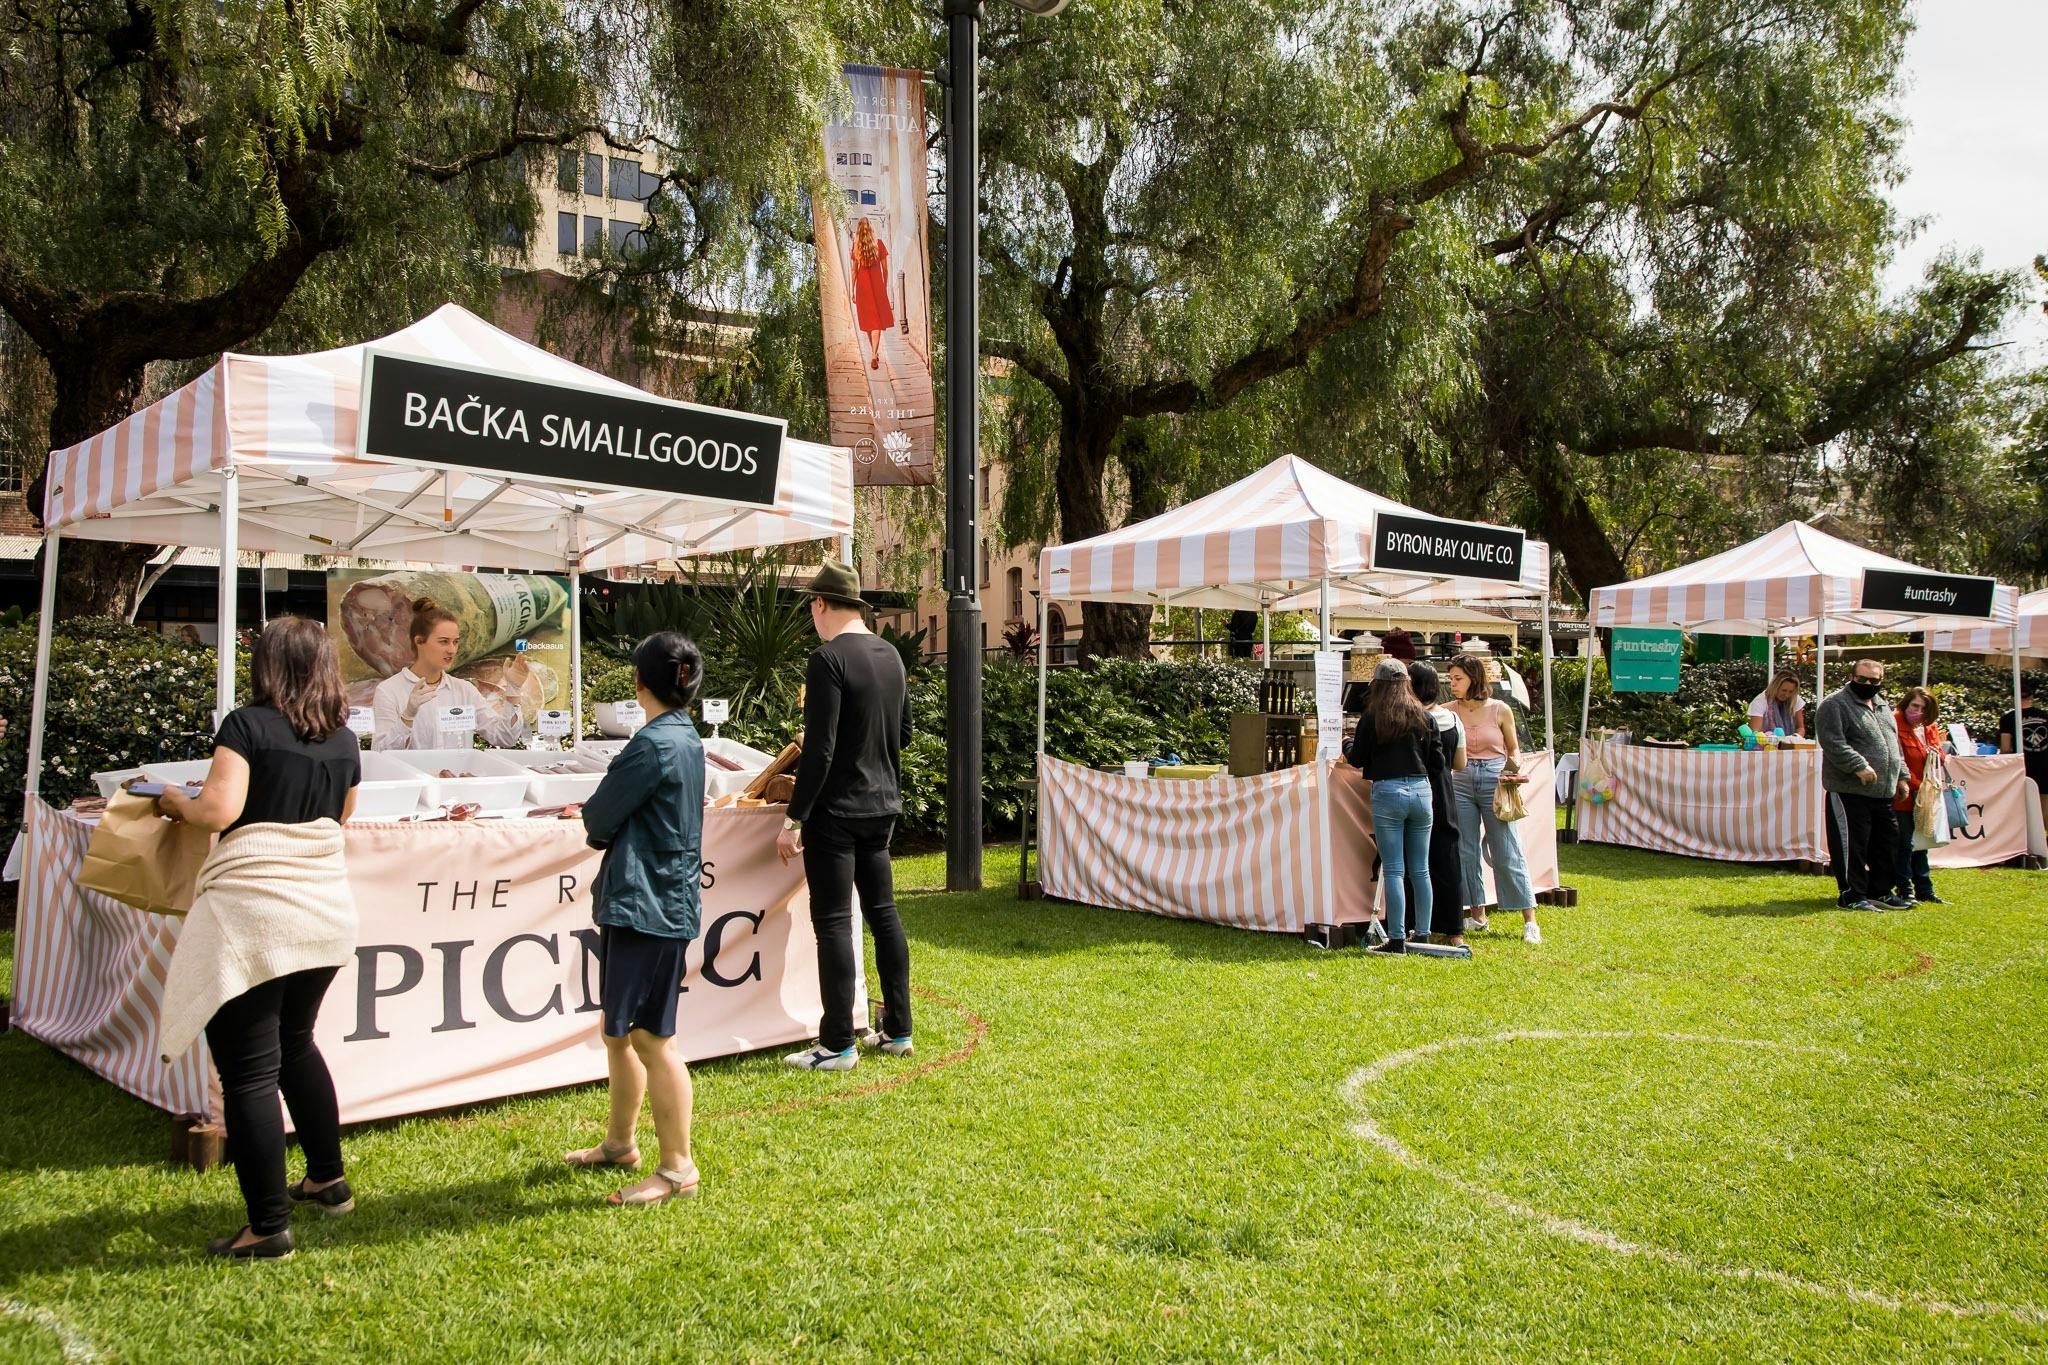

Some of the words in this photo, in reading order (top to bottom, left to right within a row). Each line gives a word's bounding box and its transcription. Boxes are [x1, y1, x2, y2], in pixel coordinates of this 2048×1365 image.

[404, 392, 529, 443] BAČKA
[540, 414, 758, 475] SMALLGOODS
[1387, 531, 1432, 556] BYRON
[1435, 537, 1459, 558] BAY
[1460, 541, 1494, 562] OLIVE
[1496, 545, 1514, 565] CO.
[1904, 585, 1958, 606] #untrashy
[1614, 639, 1680, 656] #untrashy
[417, 879, 511, 912] THE
